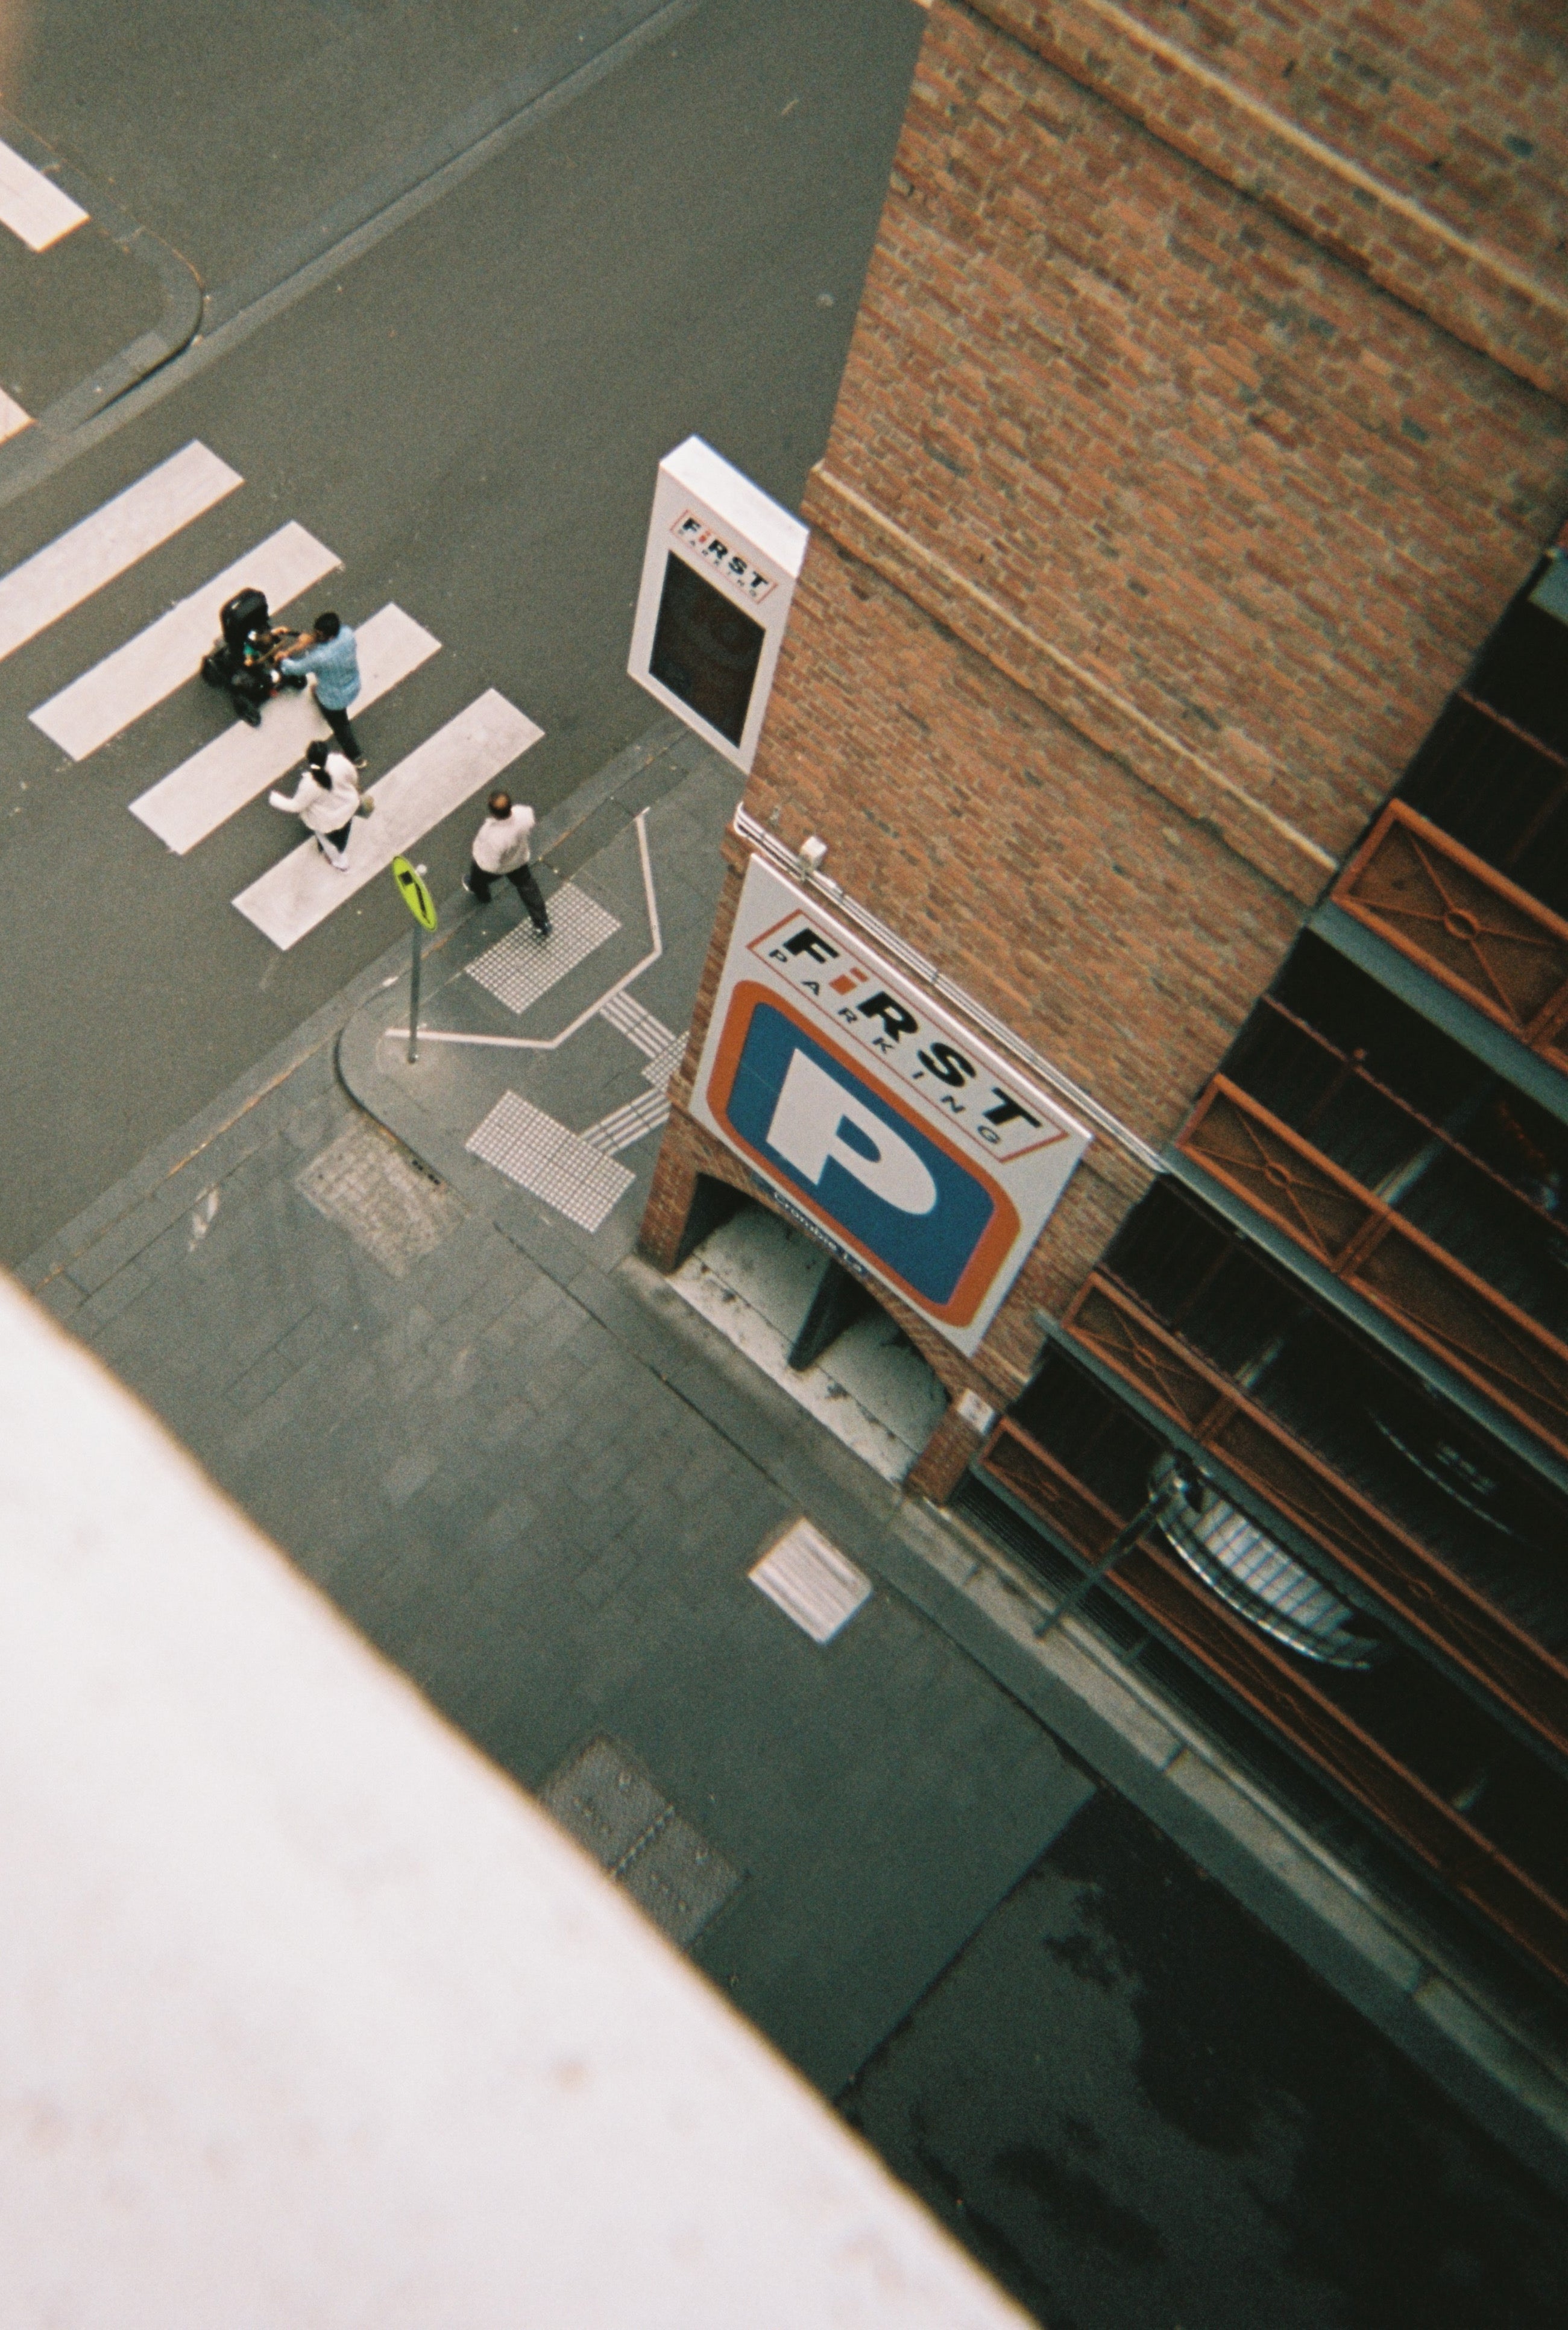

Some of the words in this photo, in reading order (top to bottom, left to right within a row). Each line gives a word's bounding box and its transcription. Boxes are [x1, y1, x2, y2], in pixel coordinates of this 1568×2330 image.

[678, 529, 758, 598] PARKING
[769, 948, 1001, 1145] PARKING
[766, 1047, 937, 1215] P
